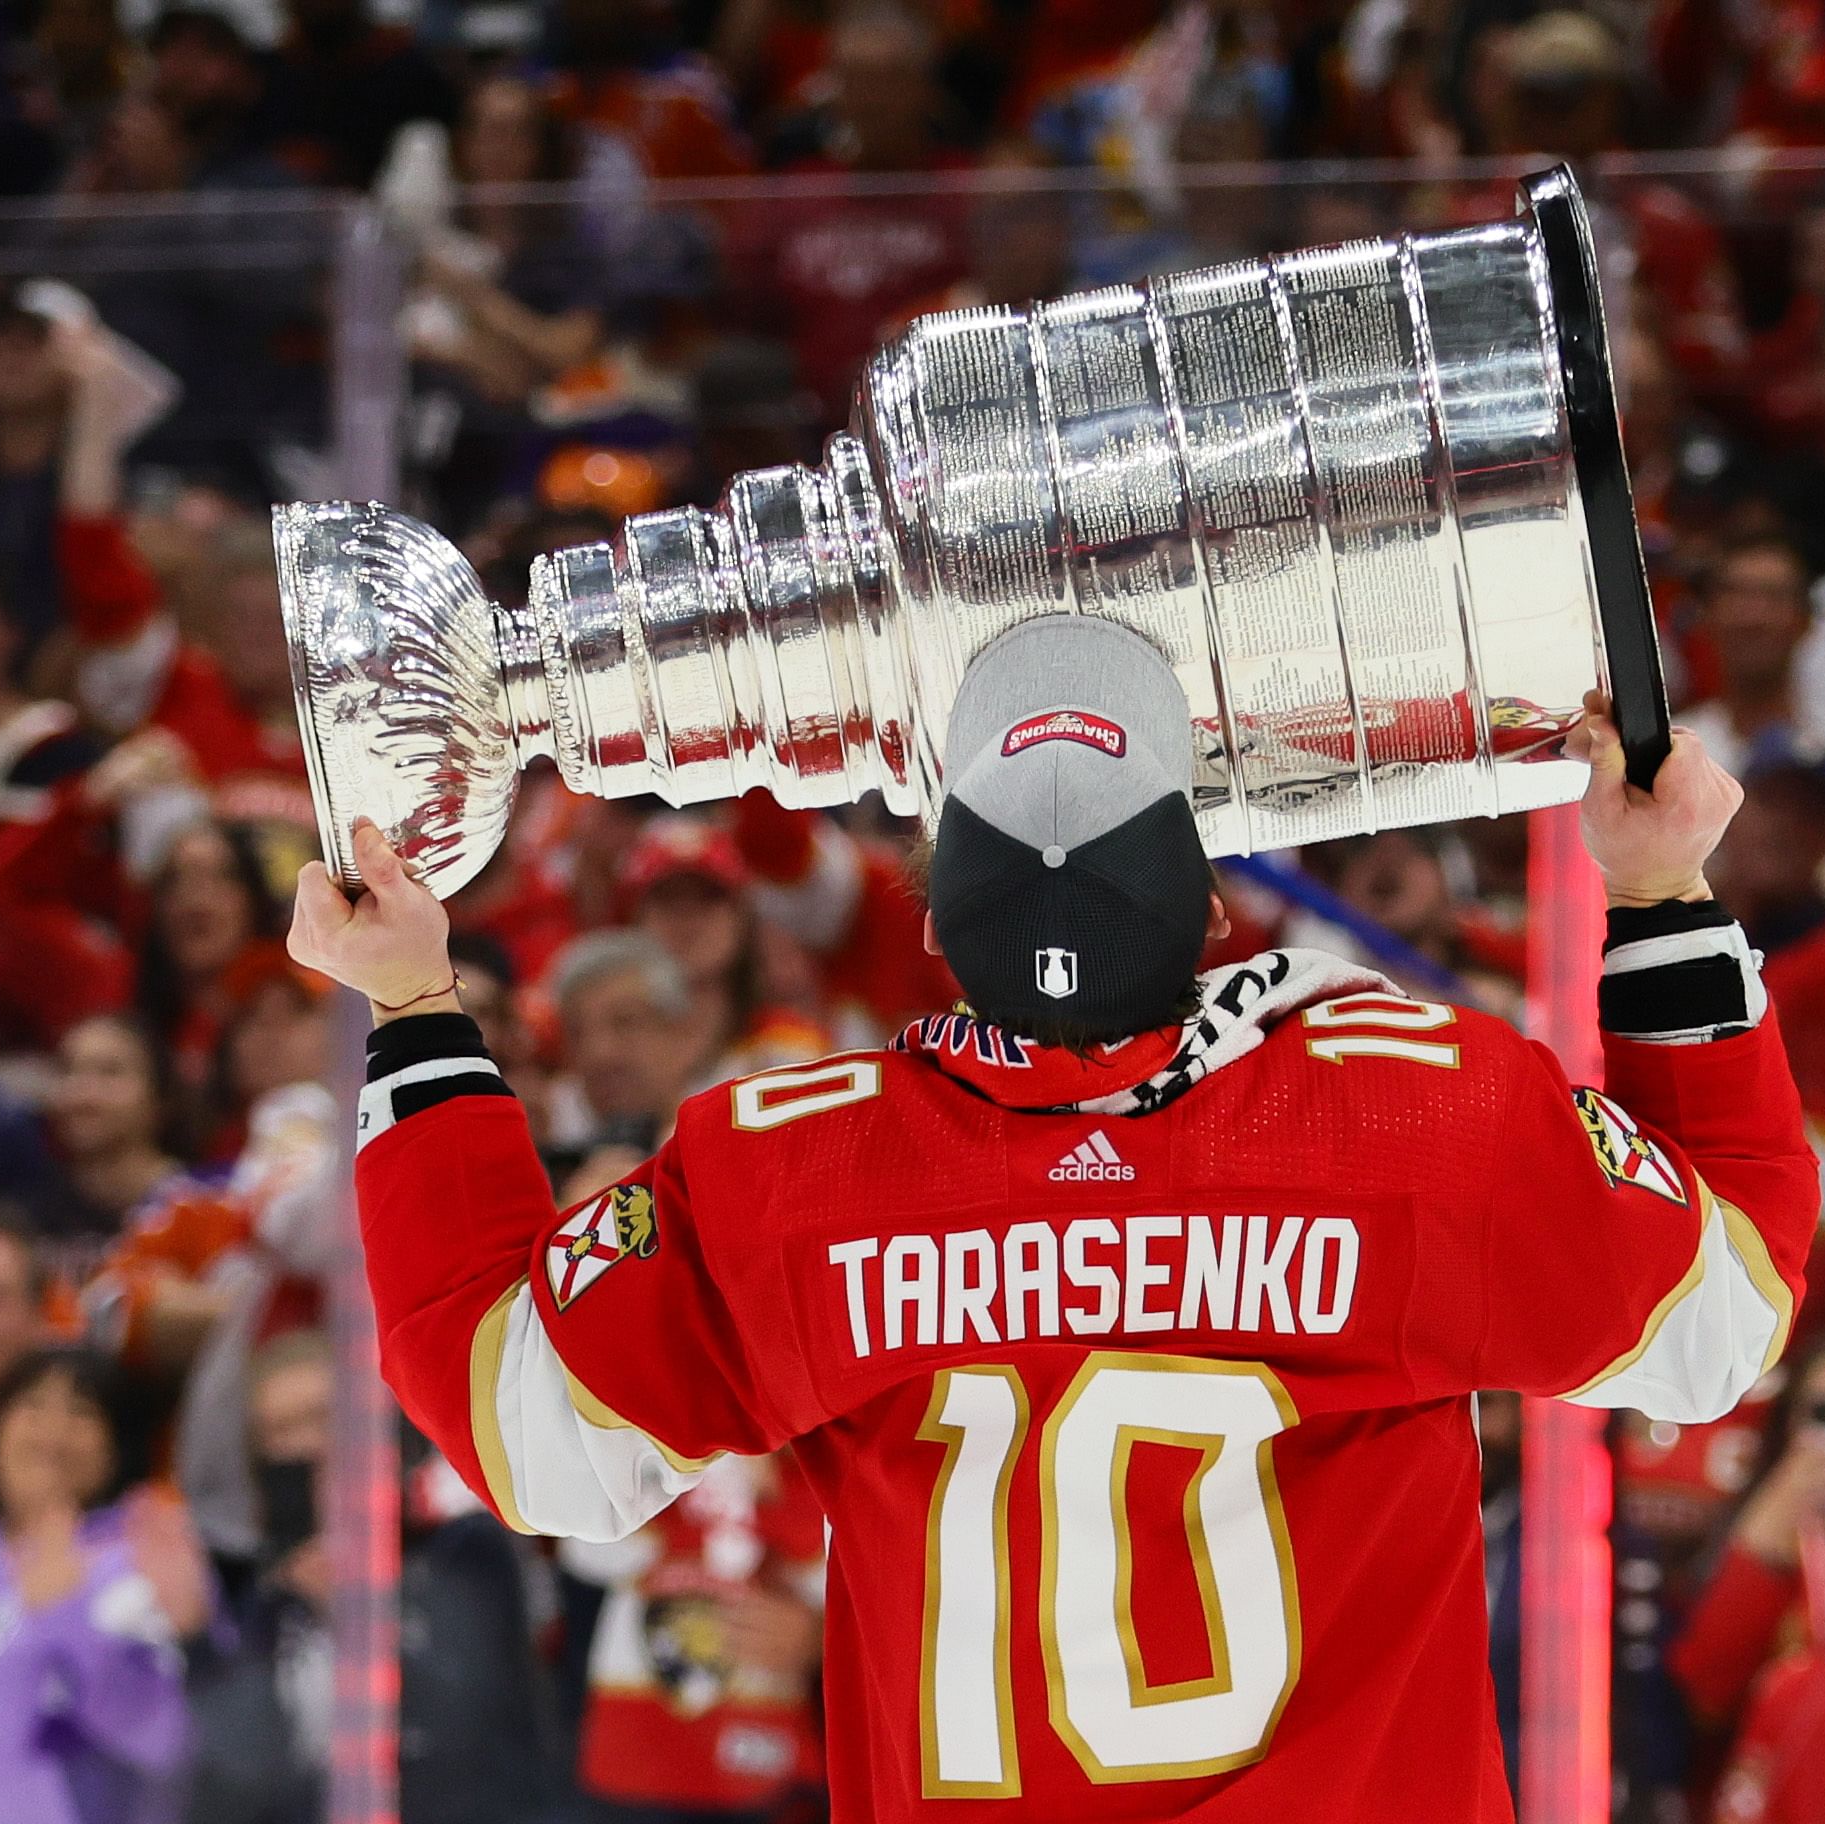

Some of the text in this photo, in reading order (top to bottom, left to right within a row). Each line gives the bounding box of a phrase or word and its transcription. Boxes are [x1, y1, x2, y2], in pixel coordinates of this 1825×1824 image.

[1010, 725, 1120, 743] CHAMPIONS
[1300, 990, 1461, 1069] 10
[1048, 1160, 1136, 1183] adidas
[828, 1215, 1360, 1358] TARASENKO
[915, 1350, 1302, 1800] 10
